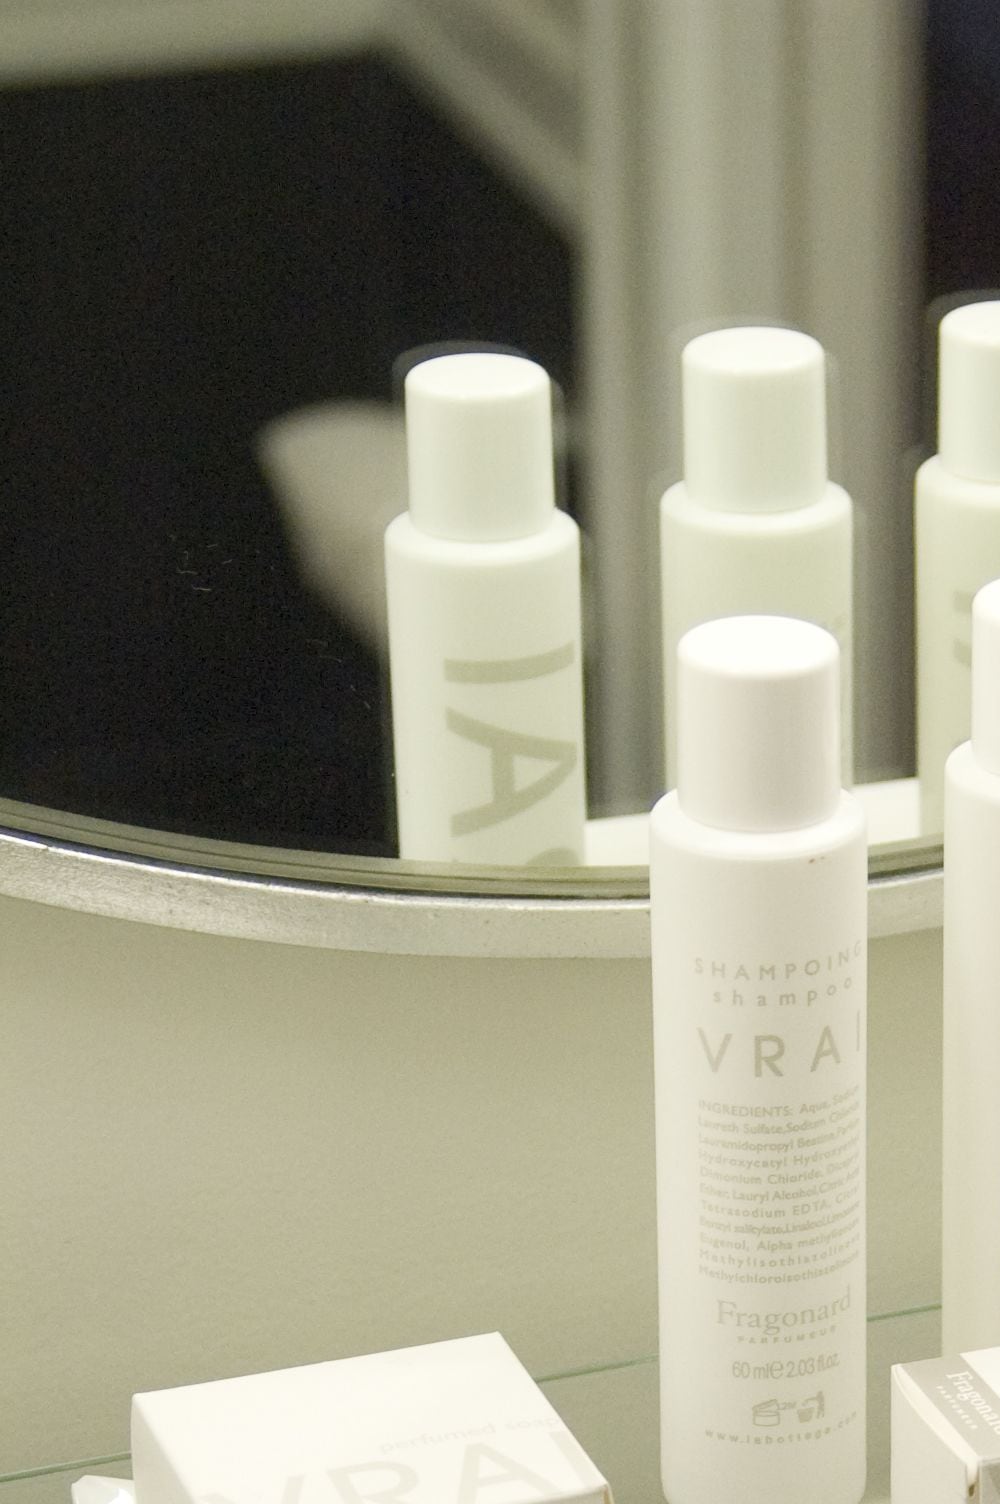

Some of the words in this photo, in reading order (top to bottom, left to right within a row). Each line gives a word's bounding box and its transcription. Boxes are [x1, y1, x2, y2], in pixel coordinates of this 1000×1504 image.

[713, 977, 852, 1007] shampoo
[696, 1009, 861, 1078] VRAI
[699, 1099, 793, 1117] INGREDIENTS:
[732, 1189, 769, 1204] Lauryl
[756, 1239, 793, 1254] Alpha
[716, 1284, 851, 1335] Fragonard
[732, 1361, 750, 1379] 60
[379, 1422, 496, 1455] perfumed
